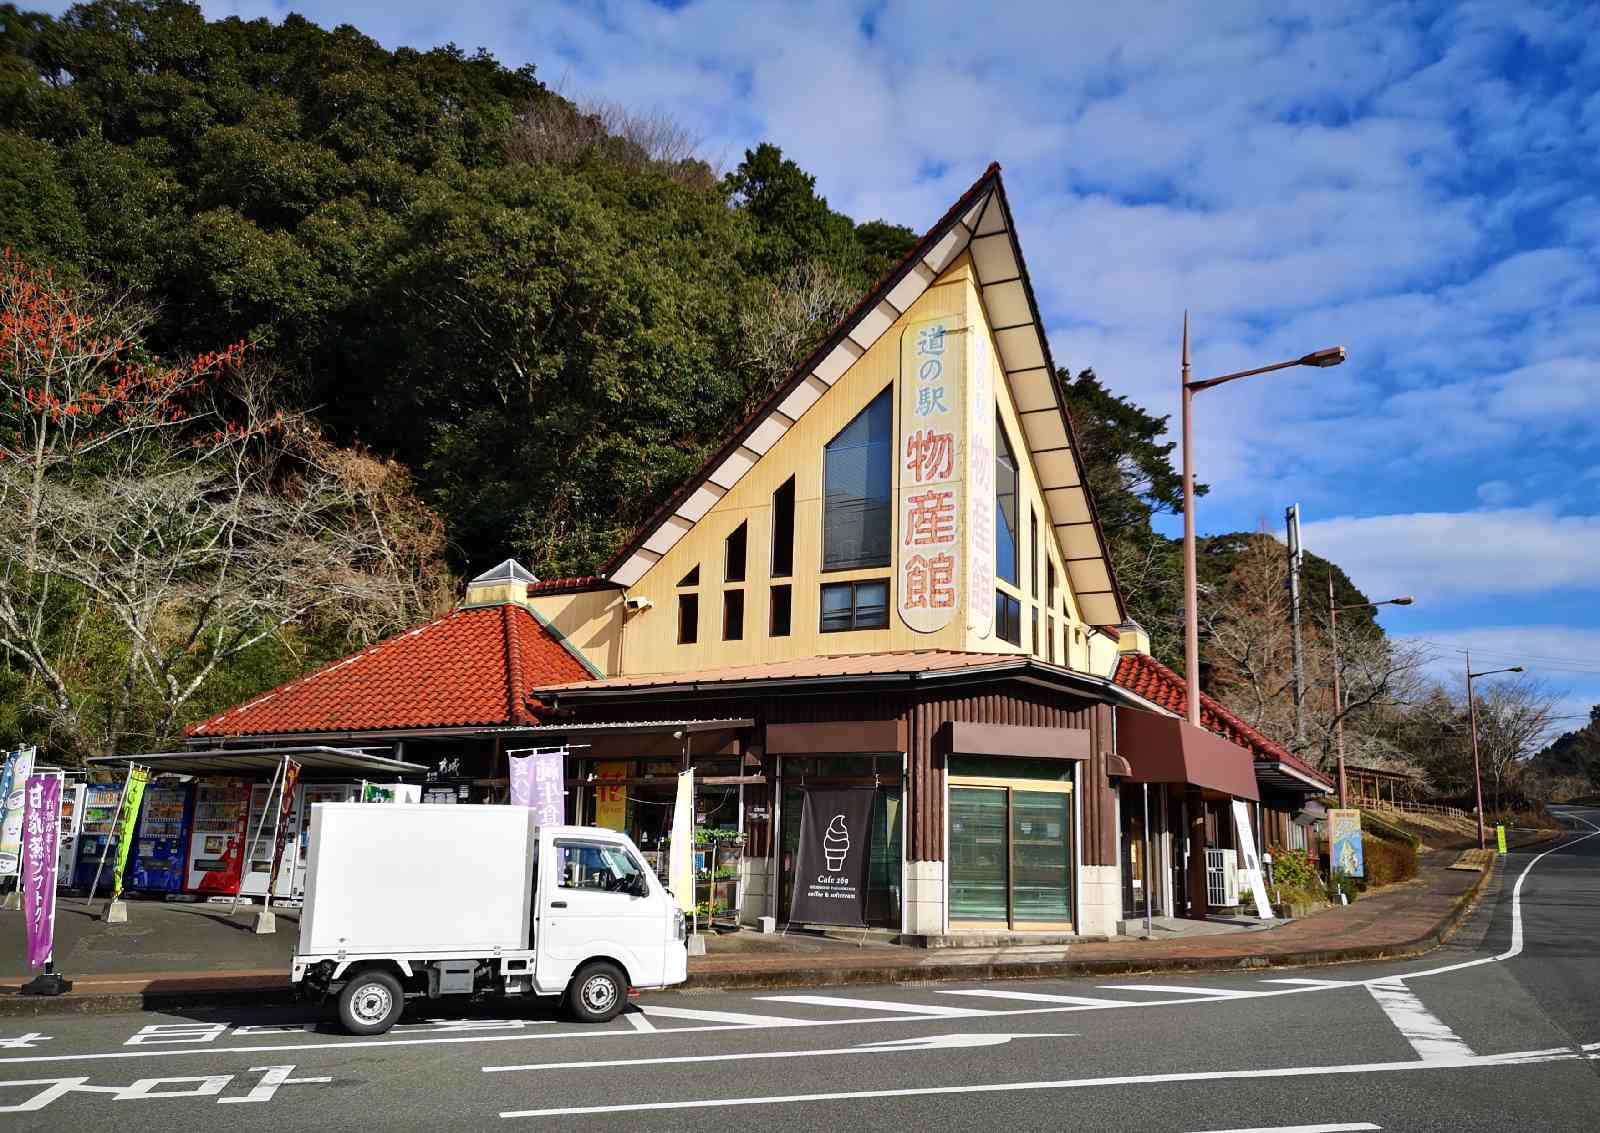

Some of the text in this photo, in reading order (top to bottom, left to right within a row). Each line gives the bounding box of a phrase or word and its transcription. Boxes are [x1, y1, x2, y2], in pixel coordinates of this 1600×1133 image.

[904, 325, 955, 609] 道の駅 物産館
